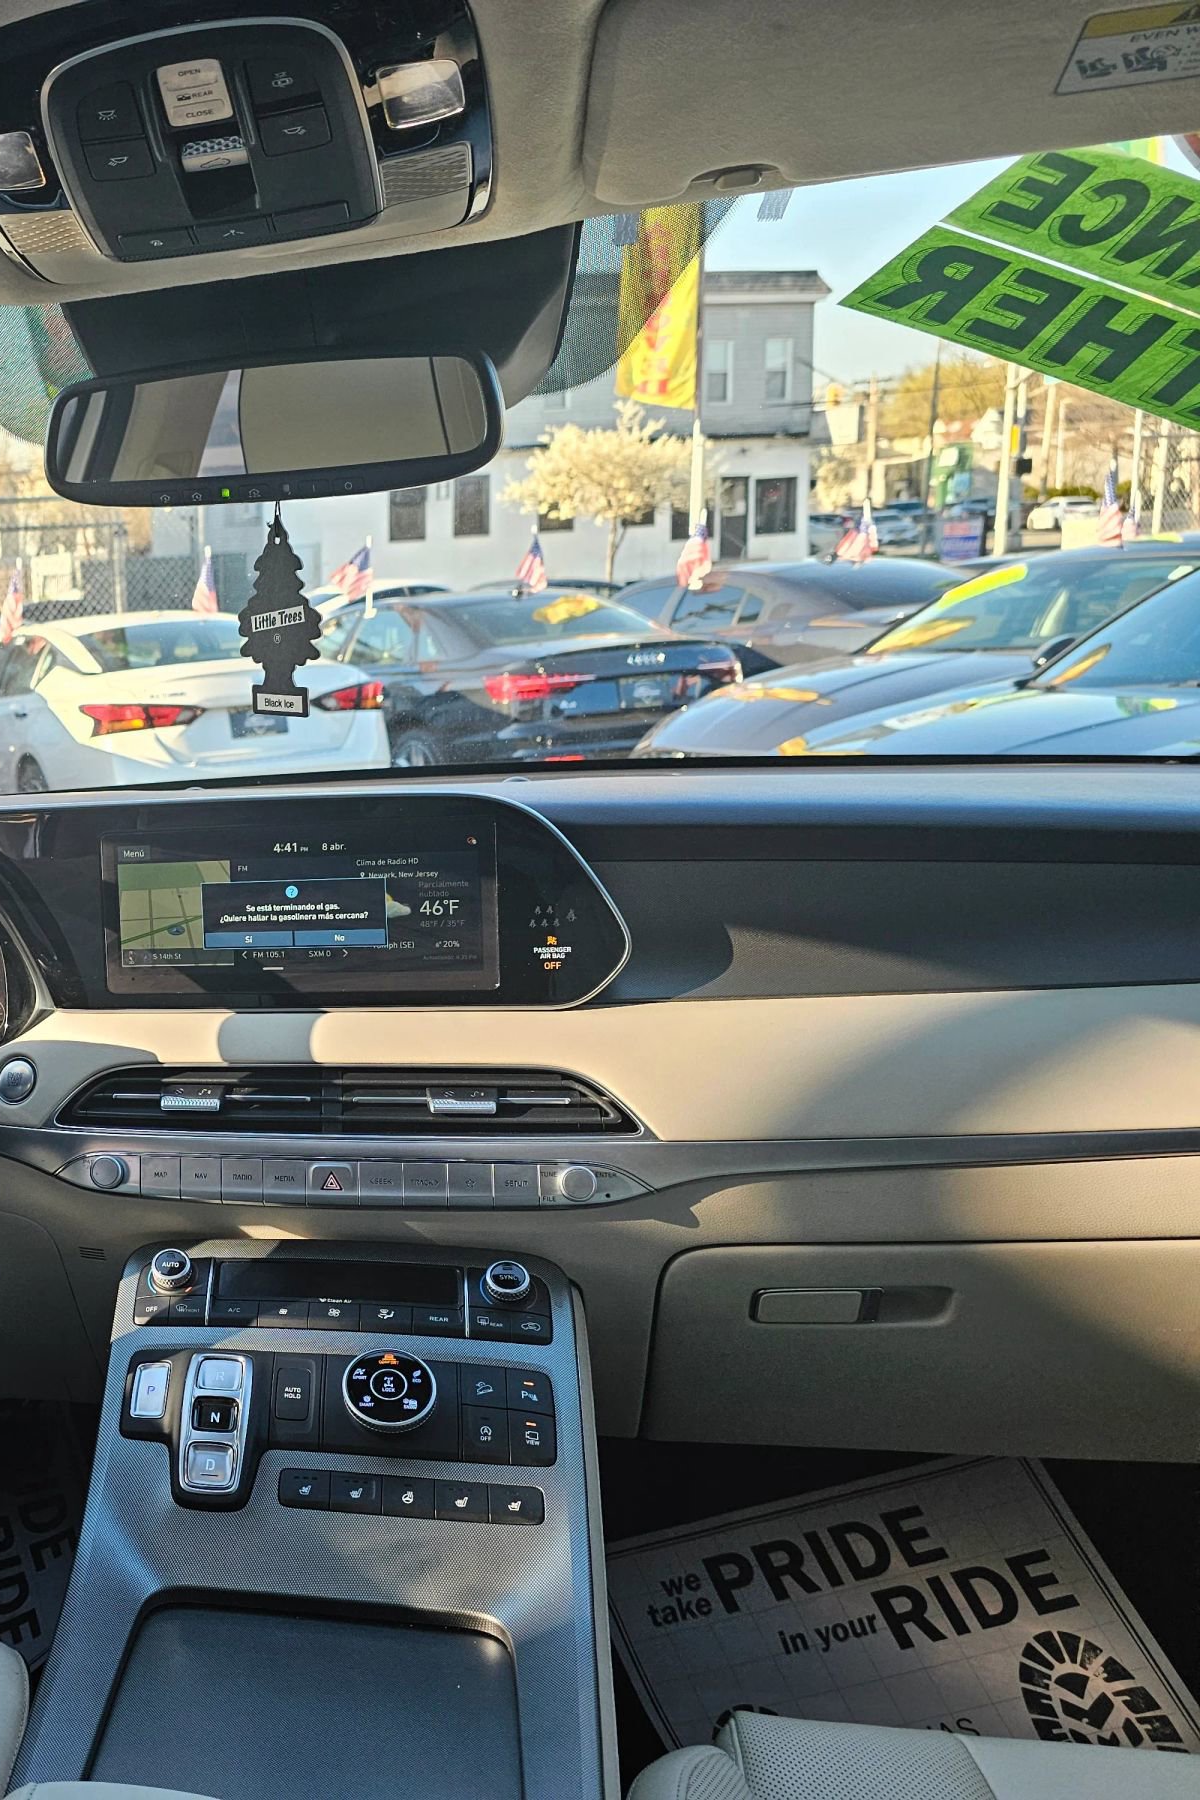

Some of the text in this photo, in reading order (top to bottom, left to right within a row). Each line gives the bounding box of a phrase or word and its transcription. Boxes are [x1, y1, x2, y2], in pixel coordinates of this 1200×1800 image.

[177, 69, 201, 77] OPEN
[191, 90, 213, 98] REAR
[185, 109, 214, 118] CLOSE
[254, 610, 303, 630] Little Trees
[264, 697, 295, 709] Black Ice
[273, 842, 298, 853] 4:41
[322, 842, 347, 851] 8 abr.
[123, 848, 145, 858] Menú
[355, 857, 419, 866] Clima de Radio HD
[399, 870, 414, 879] New
[415, 870, 439, 879] Jersey
[418, 880, 469, 889] Parcialmente
[418, 889, 450, 898] nublado
[256, 904, 273, 912] está
[273, 903, 316, 912] terminando
[316, 902, 324, 911] el
[324, 904, 340, 913] gas.
[419, 899, 460, 916] 46°F
[219, 911, 369, 924] ¿Quiere hallar la gasolinera más cercana?
[244, 934, 345, 944] Sí No
[400, 941, 415, 950] (SE)
[443, 940, 460, 948] 20%
[533, 946, 572, 954] PASSENGER
[265, 951, 286, 959] 105.1
[539, 952, 566, 960] AIR BAG
[543, 961, 562, 970] OFF
[153, 1171, 167, 1179] MAP
[194, 1172, 208, 1180] NAV
[232, 1173, 253, 1181] RADIO
[504, 1180, 529, 1188] SETUP
[215, 1371, 225, 1381] R
[146, 1385, 156, 1395] P
[210, 1412, 221, 1424] N
[205, 1458, 216, 1471] D
[647, 1504, 950, 1629] take PRIDE
[660, 1572, 702, 1599] we
[778, 1548, 1081, 1656] in your RIDE
